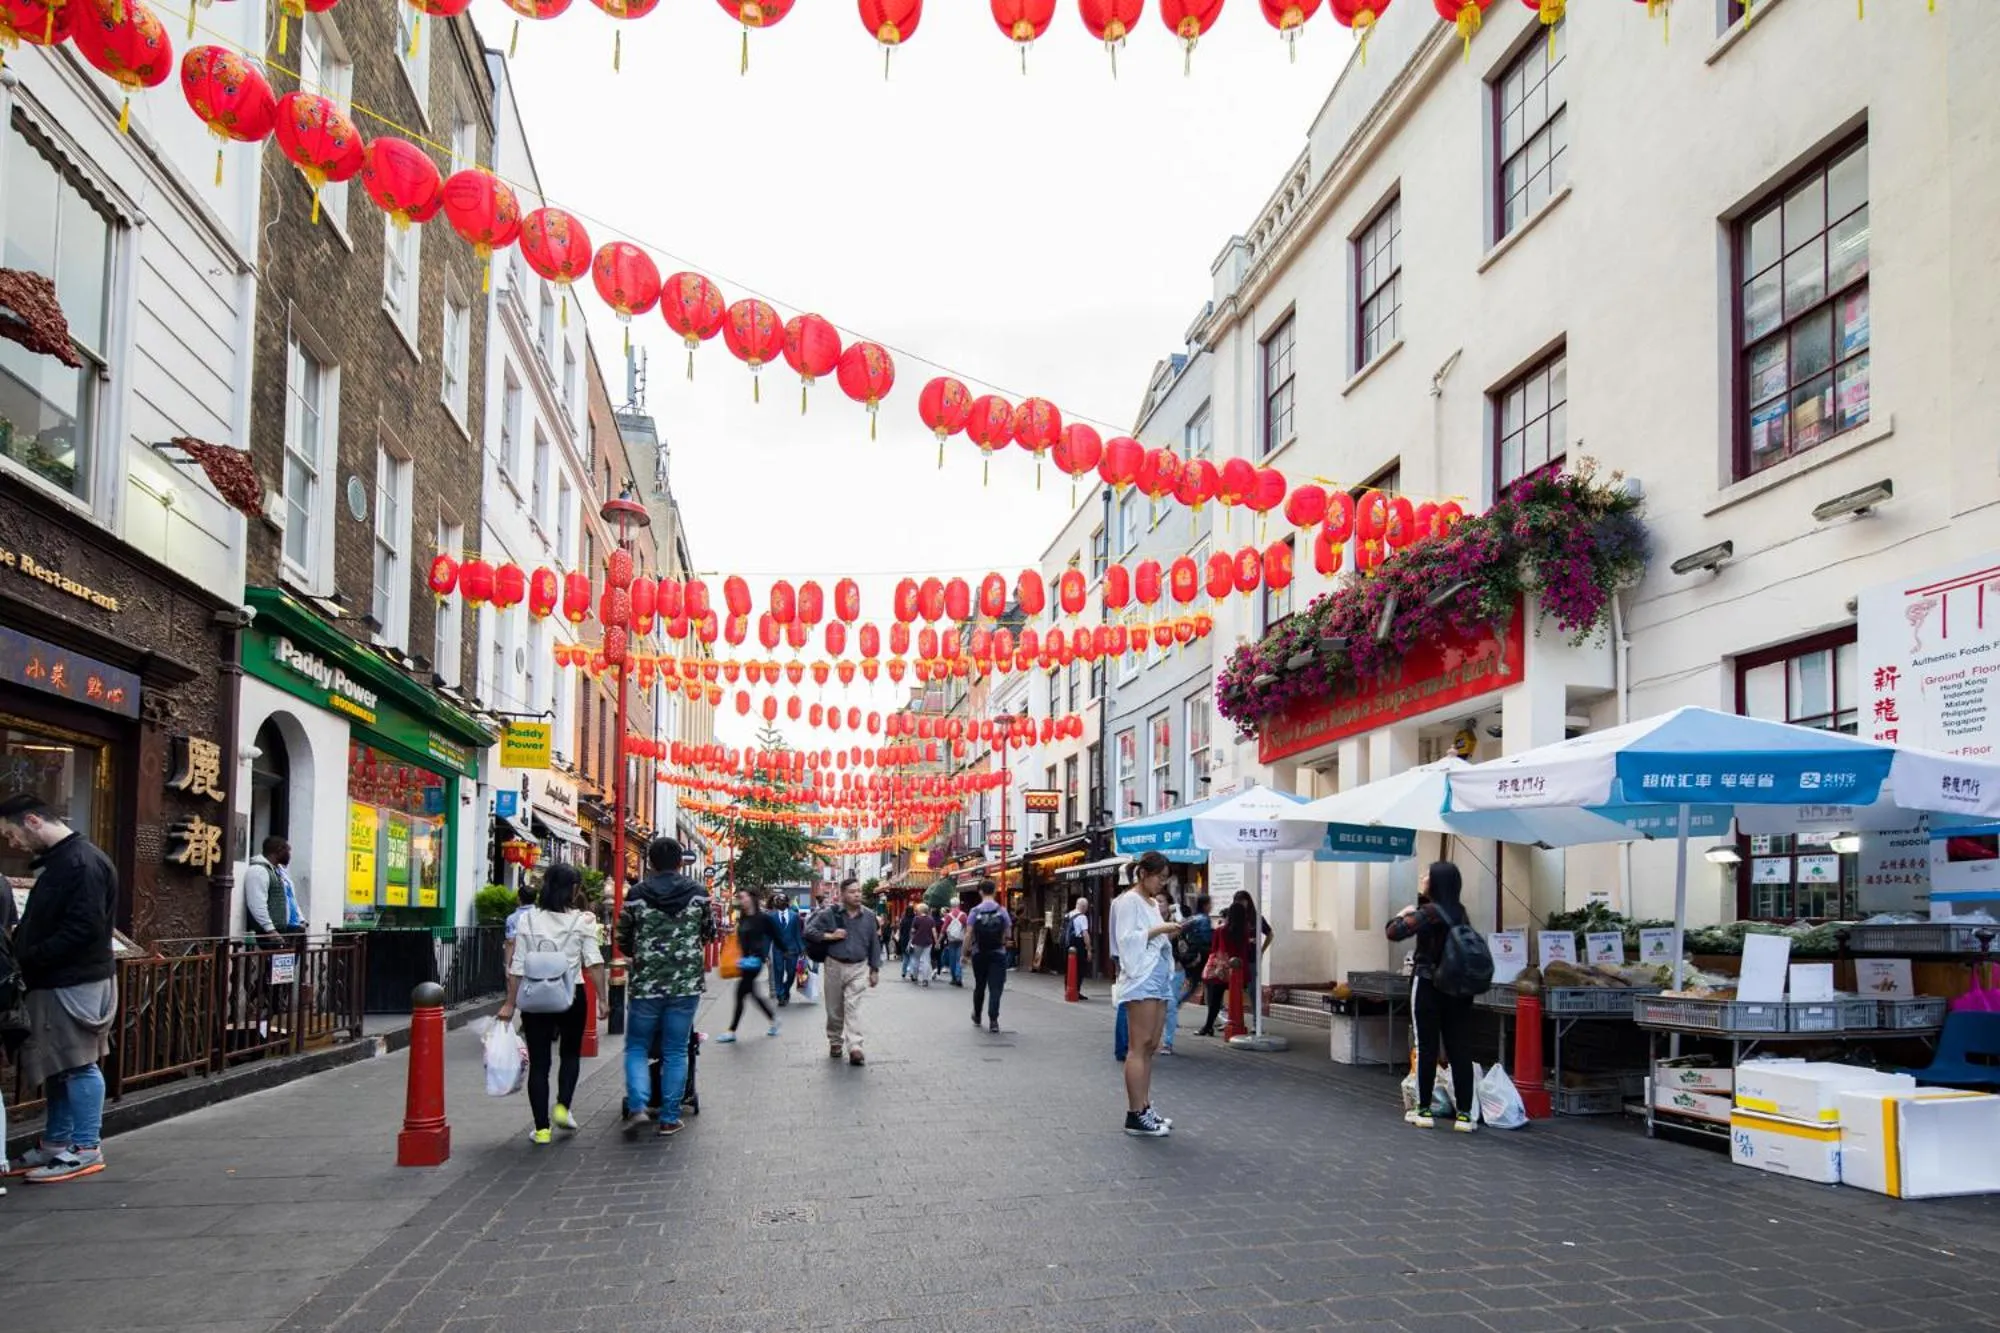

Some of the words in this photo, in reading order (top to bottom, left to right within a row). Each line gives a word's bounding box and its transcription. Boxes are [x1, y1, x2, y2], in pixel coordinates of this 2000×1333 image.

[21, 553, 118, 612] Restaurant
[1912, 651, 1957, 667] Authentic
[1960, 644, 1991, 656] Foods
[279, 635, 332, 690] Paddy
[335, 666, 378, 709] Power
[1925, 669, 1965, 686] Ground
[1972, 663, 2000, 675] Floor
[1375, 649, 1495, 715] Supermarket
[1965, 677, 1988, 687] Kong
[1943, 687, 1985, 700] Indonesia
[1945, 697, 1983, 708] Malaysia
[1941, 706, 1988, 720] Philippines
[1942, 715, 1986, 729] Singapore
[507, 727, 545, 739] Paddy
[1946, 725, 1983, 737] Thailand
[507, 740, 545, 751] Power
[1962, 745, 1993, 757] Floor
